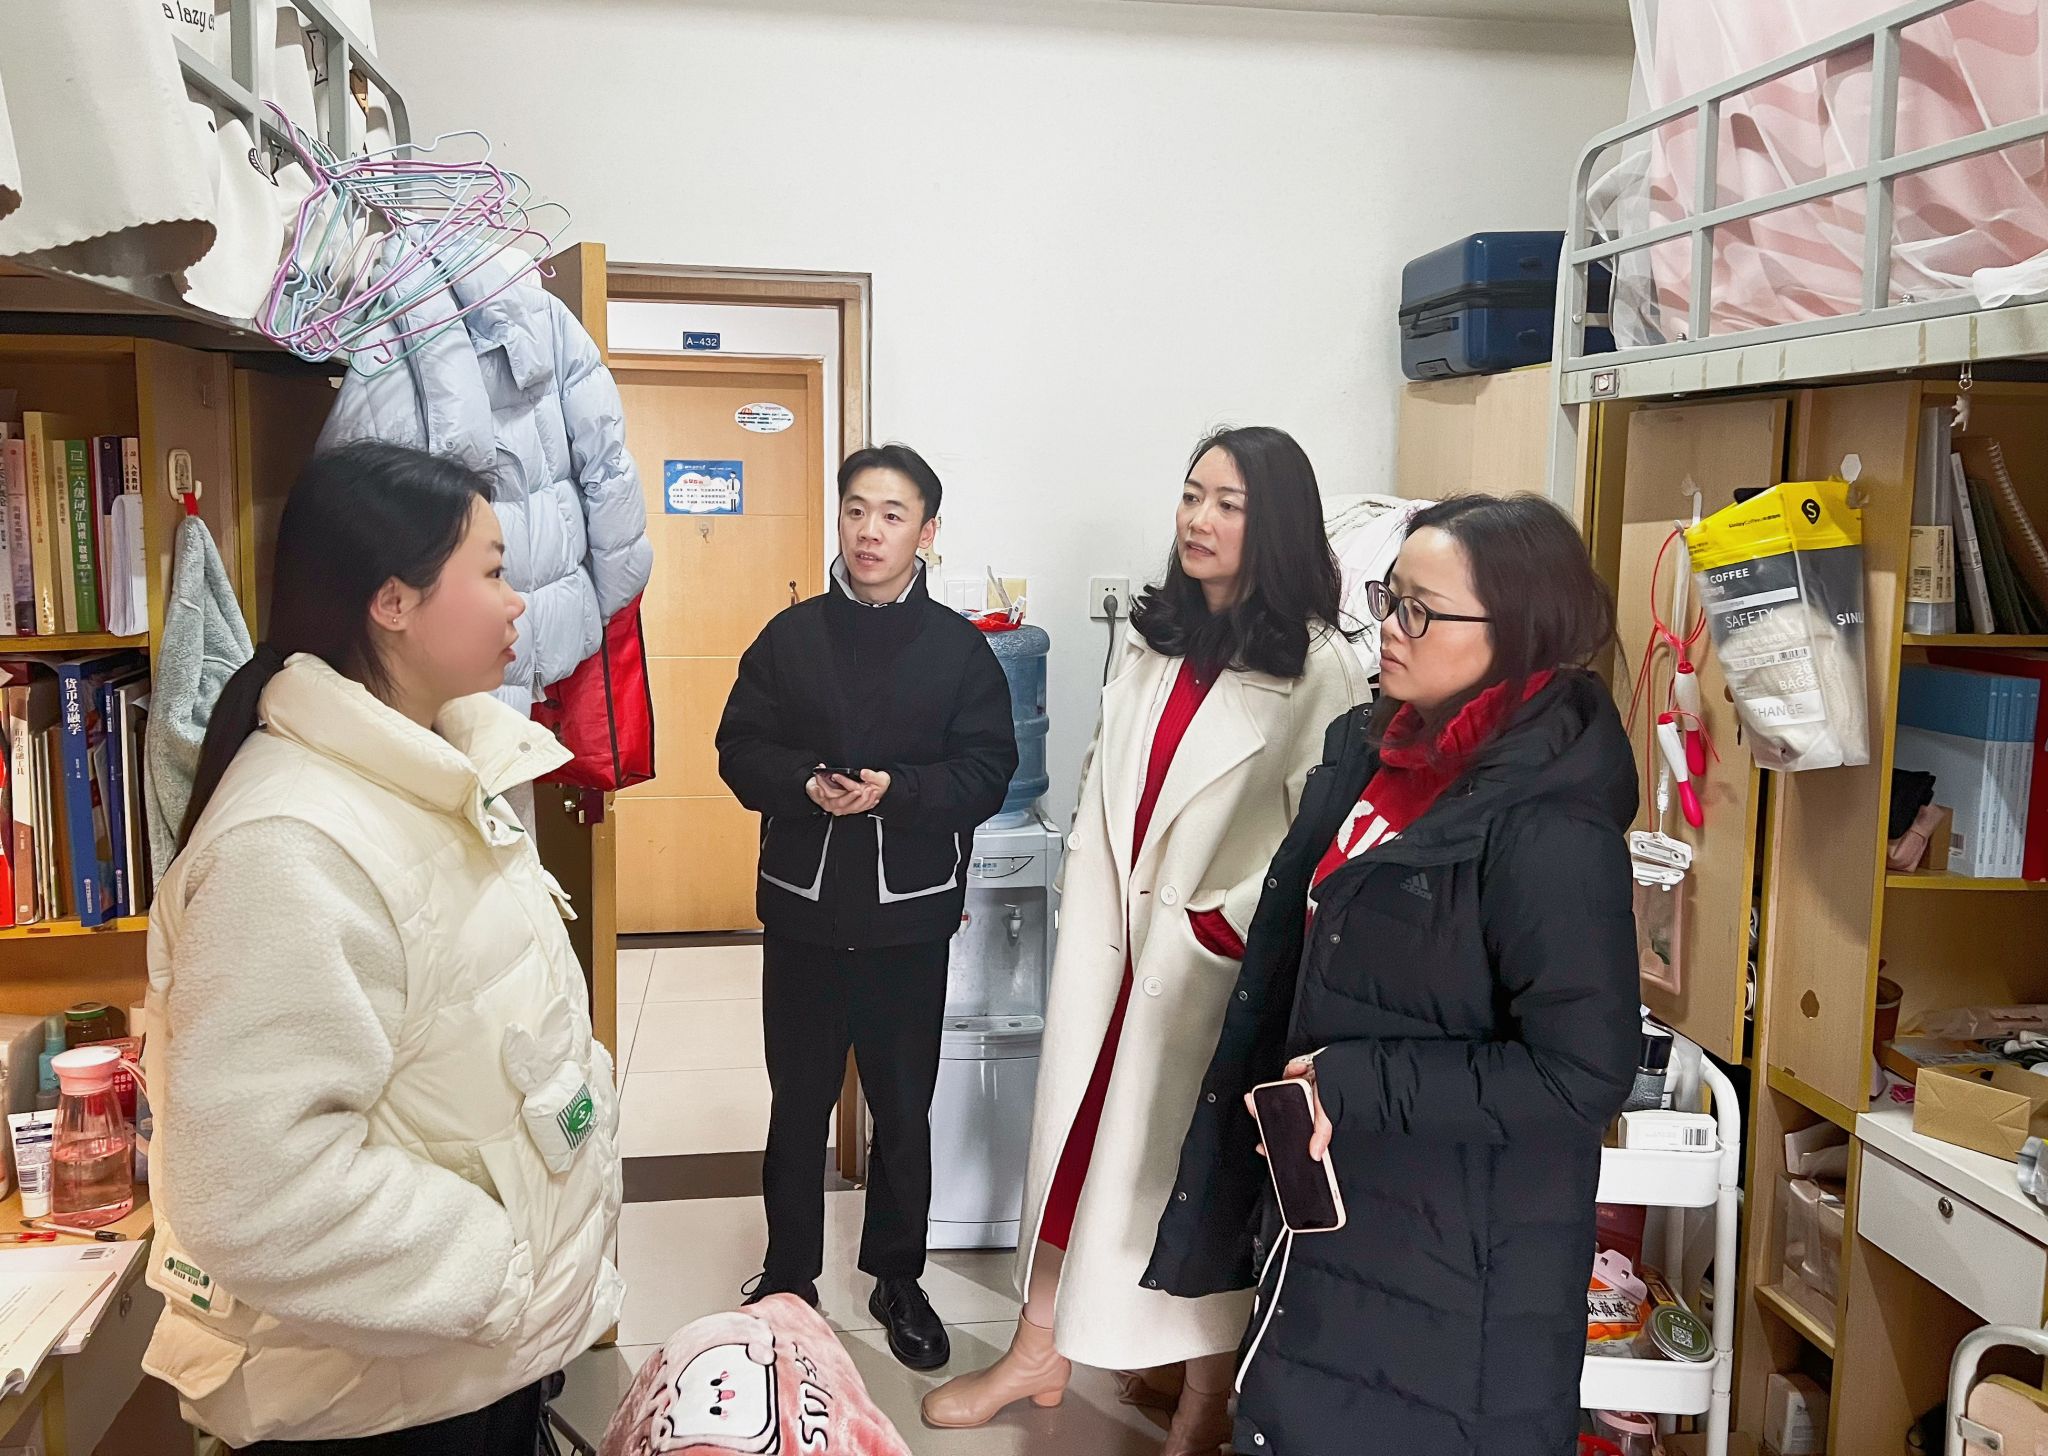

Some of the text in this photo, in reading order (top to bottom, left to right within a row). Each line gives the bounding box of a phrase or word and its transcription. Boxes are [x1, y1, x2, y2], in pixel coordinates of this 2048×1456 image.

[162, 3, 174, 19] a
[177, 0, 206, 32] lazy
[686, 336, 718, 347] A-432
[1806, 502, 1817, 518] S
[1710, 567, 1750, 584] COFFEE
[1725, 608, 1774, 629] SAFETY
[1779, 674, 1816, 690] BAGS
[64, 677, 82, 735] 货币金融学
[1753, 703, 1805, 718] HANGE
